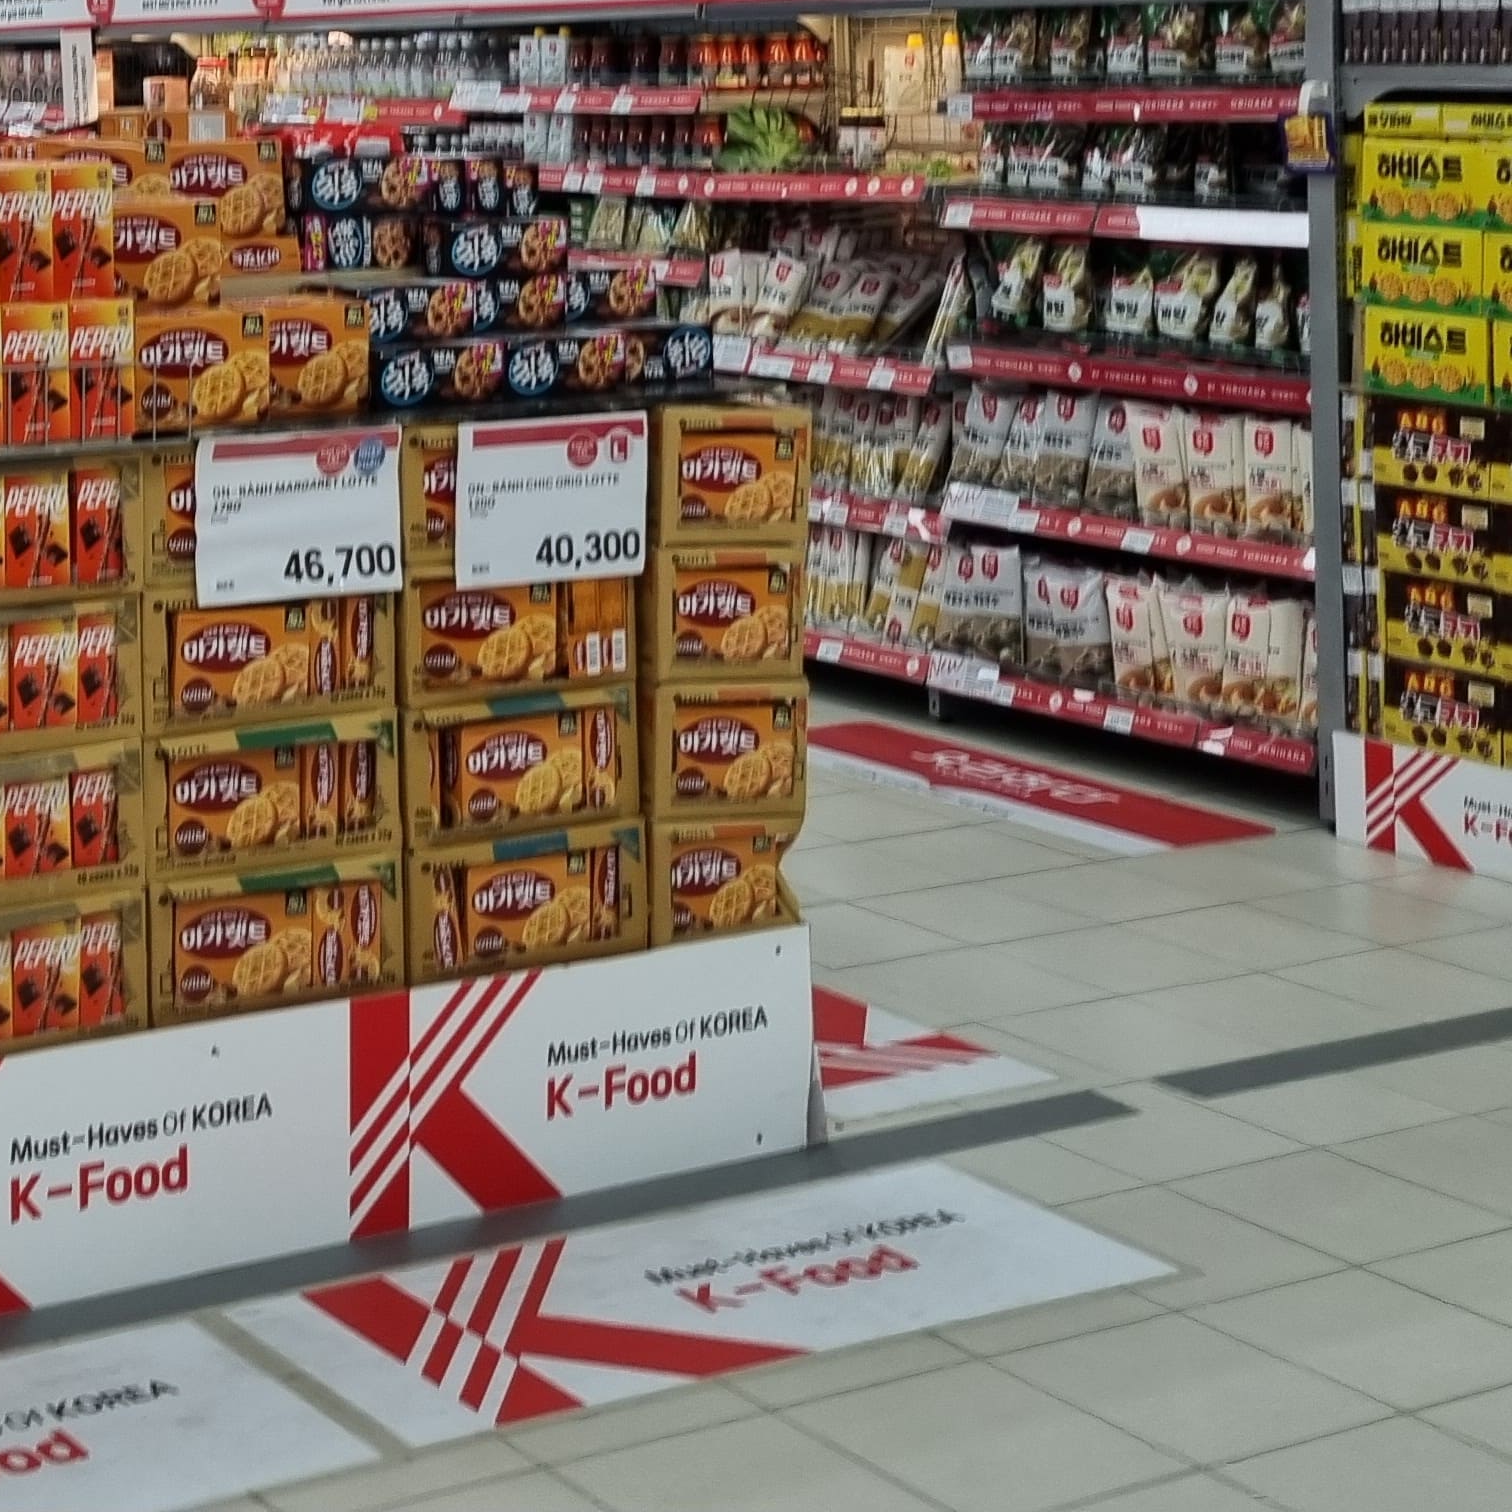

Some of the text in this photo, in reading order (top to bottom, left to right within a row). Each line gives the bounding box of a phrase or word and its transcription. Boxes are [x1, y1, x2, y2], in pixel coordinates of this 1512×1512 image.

[52, 187, 113, 218] PEPERO
[3, 330, 68, 363] PEPERO
[6, 483, 71, 516] PEPERO
[284, 541, 396, 586] 46,700
[536, 528, 640, 571] 40,300
[14, 634, 78, 667] PEPERO
[5, 781, 70, 816] PEPERO
[547, 1006, 769, 1069] Must-Haves Of KOREA
[546, 1051, 699, 1122] K-Food
[10, 1093, 273, 1165] Must-Haves Of KOREA
[10, 1143, 190, 1225] K-Food
[674, 1243, 922, 1314] K-Food
